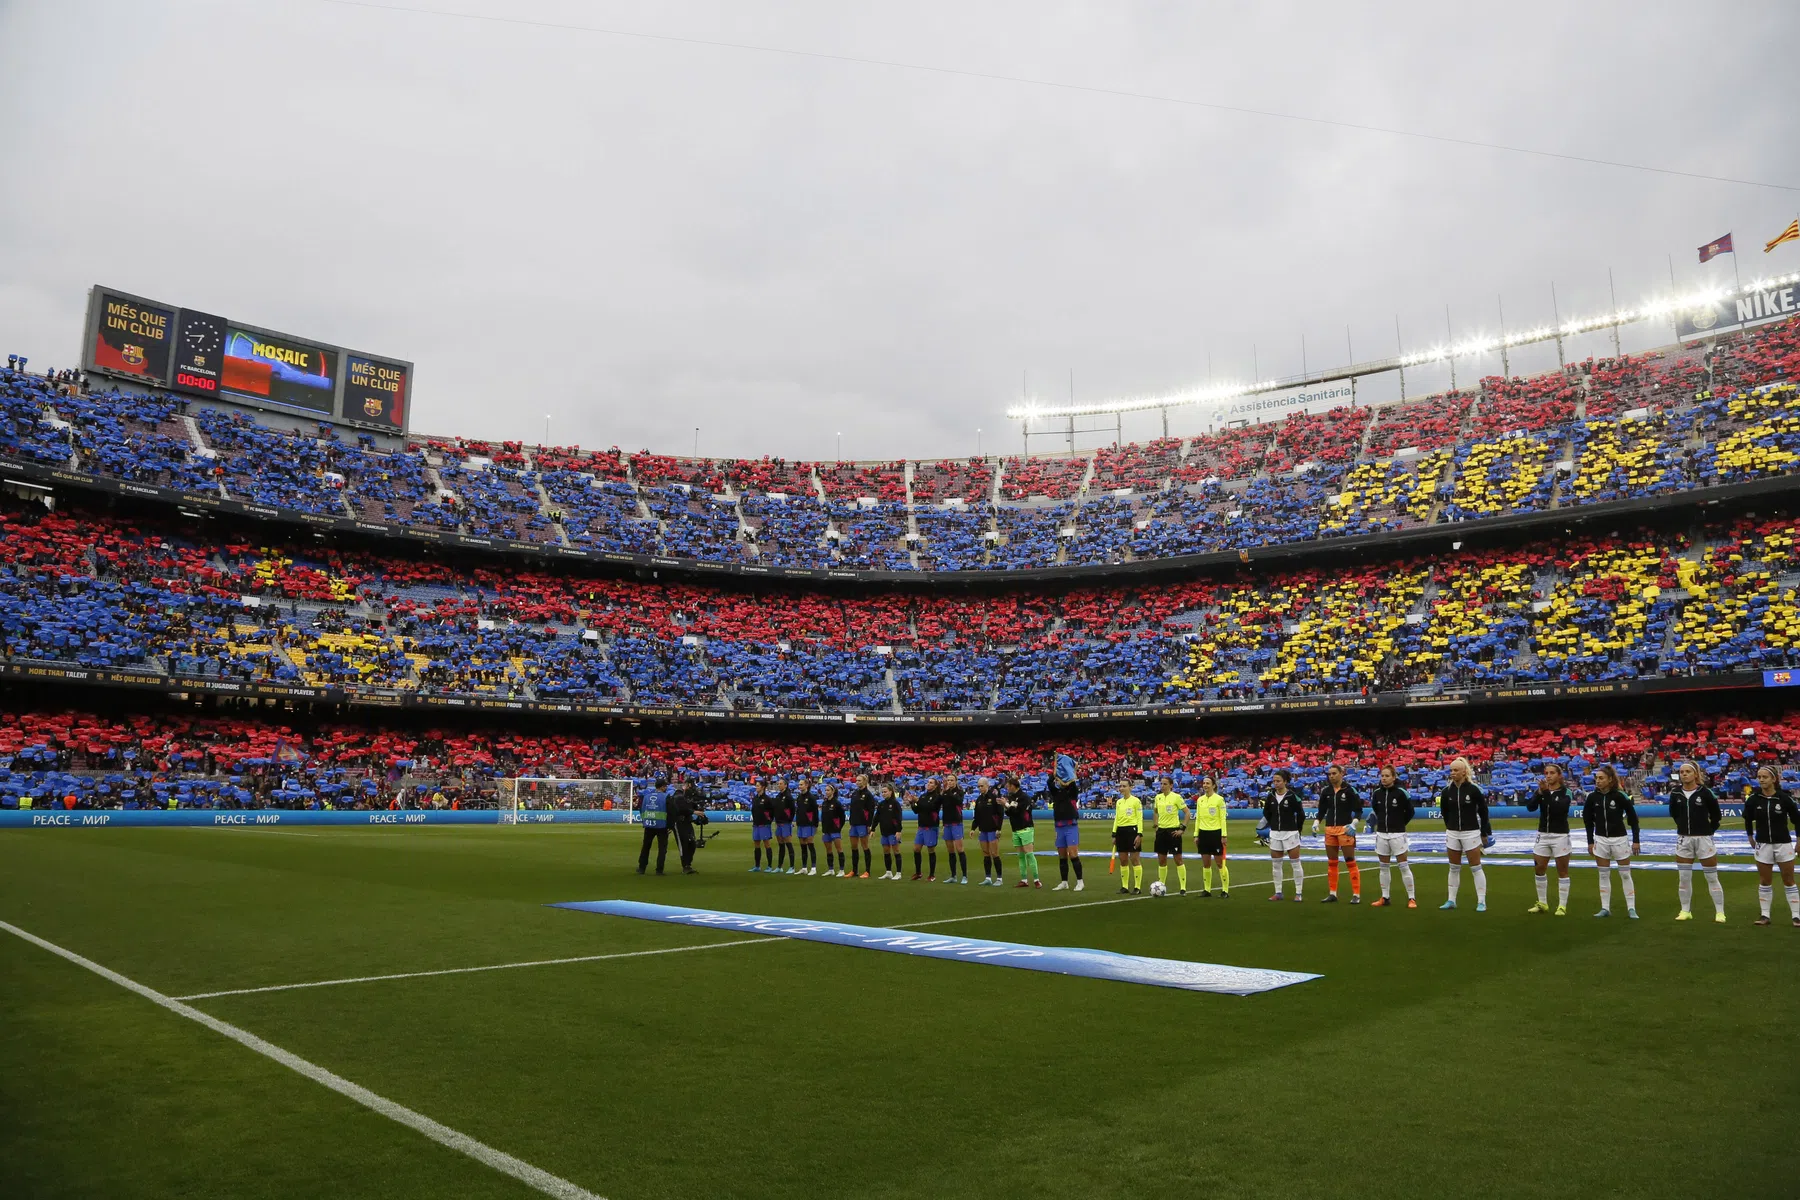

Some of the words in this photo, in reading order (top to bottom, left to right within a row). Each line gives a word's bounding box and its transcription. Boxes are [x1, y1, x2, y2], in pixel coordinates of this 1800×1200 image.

[108, 303, 137, 319] MÉS
[140, 312, 166, 327] QUE
[108, 317, 127, 330] UN
[130, 323, 163, 339] CLUB
[252, 342, 308, 367] MOSAIC
[188, 366, 216, 376] BARCELONA
[352, 363, 375, 376] MÉS
[378, 369, 400, 381] QUE
[178, 374, 215, 390] 00:00
[352, 375, 367, 386] UN
[371, 380, 398, 392] CLUB
[1230, 397, 1296, 414] Assistència
[1298, 387, 1350, 403] Sanitària
[33, 816, 70, 824] PEACE
[215, 815, 246, 823] PEACE
[369, 814, 397, 823] PEACE
[666, 913, 841, 934] PEACE
